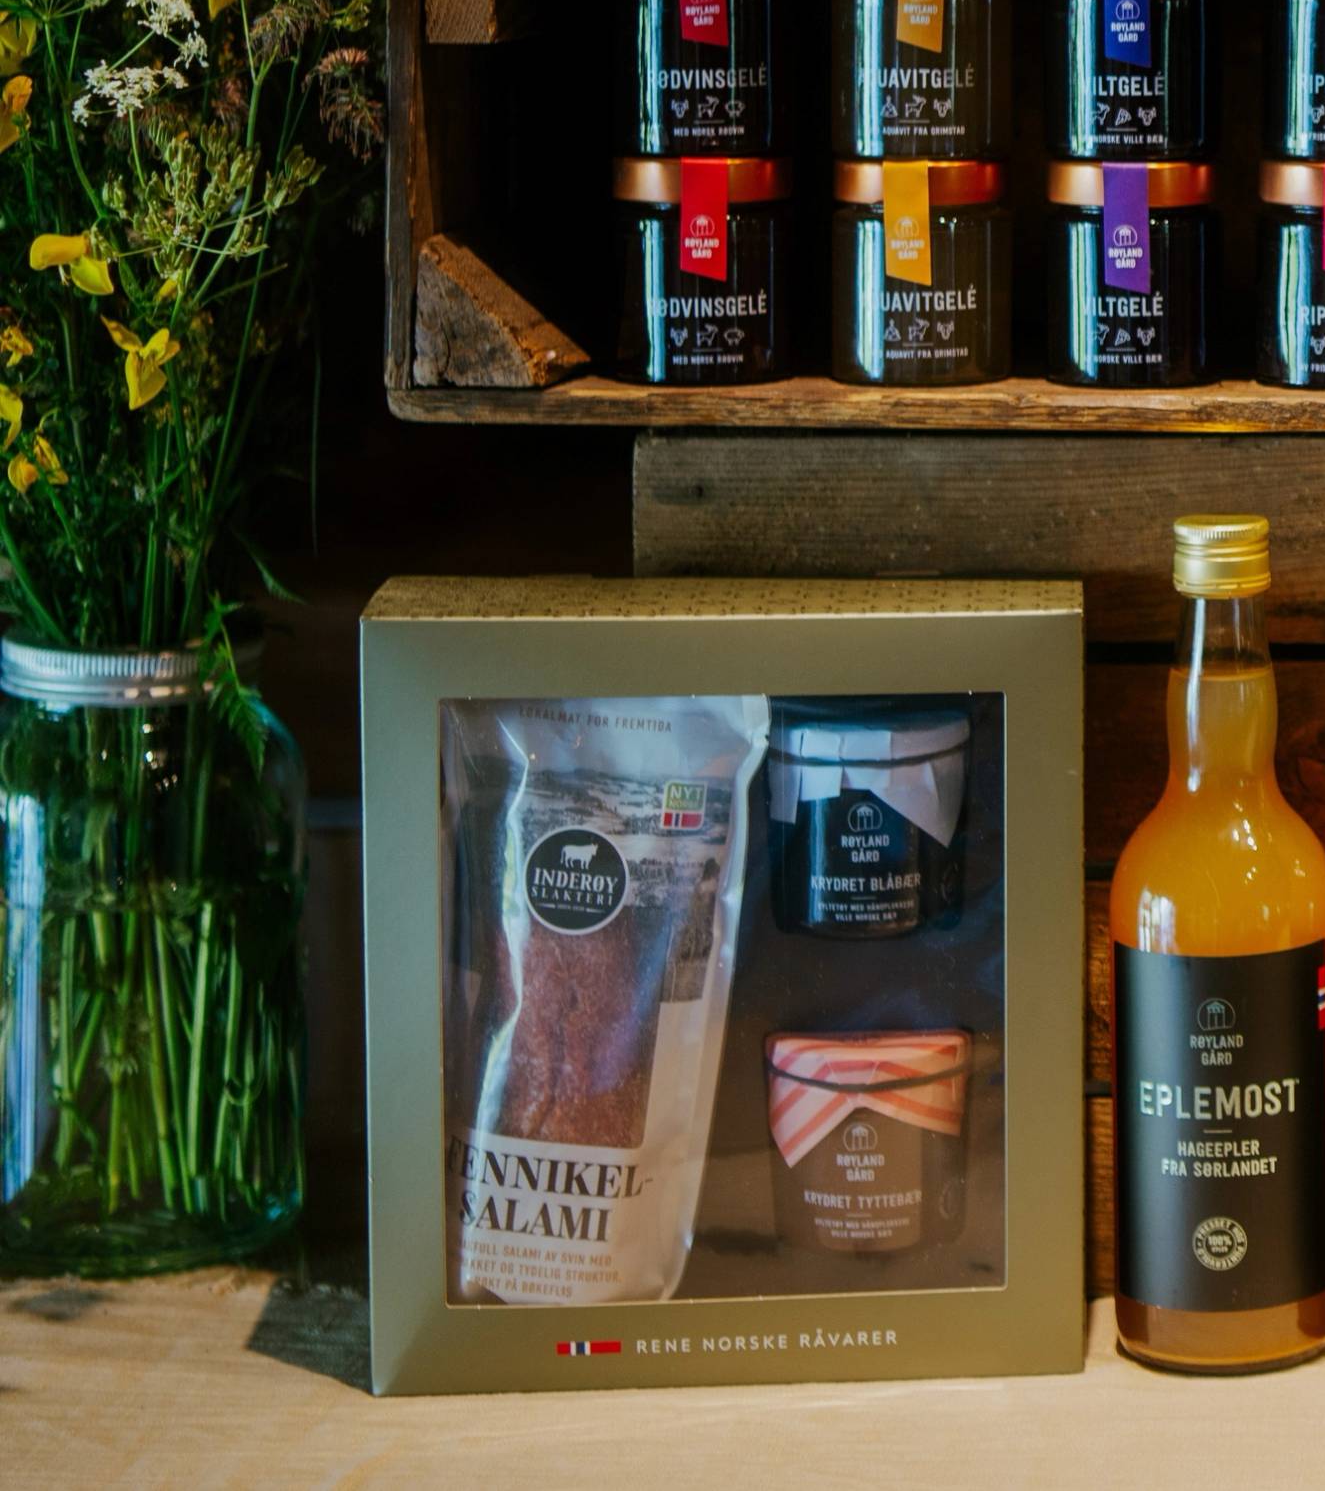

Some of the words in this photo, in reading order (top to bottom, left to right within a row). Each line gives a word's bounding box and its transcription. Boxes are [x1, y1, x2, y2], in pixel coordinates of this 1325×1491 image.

[1111, 22, 1145, 33] RØYLAND
[1118, 32, 1138, 43] GÅRD
[670, 786, 701, 799] NYT
[534, 868, 618, 893] INDERØY
[531, 886, 613, 906] SLAKTERI
[1139, 1078, 1299, 1120] EPLEMOST
[1177, 1140, 1261, 1157] HAGEEPLER
[1161, 1159, 1187, 1178] FRA
[1193, 1157, 1278, 1178] SØRLANDET
[460, 1190, 611, 1243] SALAMI
[636, 1338, 693, 1355] RENE
[703, 1334, 789, 1352] NORSKE
[799, 1328, 897, 1348] RÅVARER
